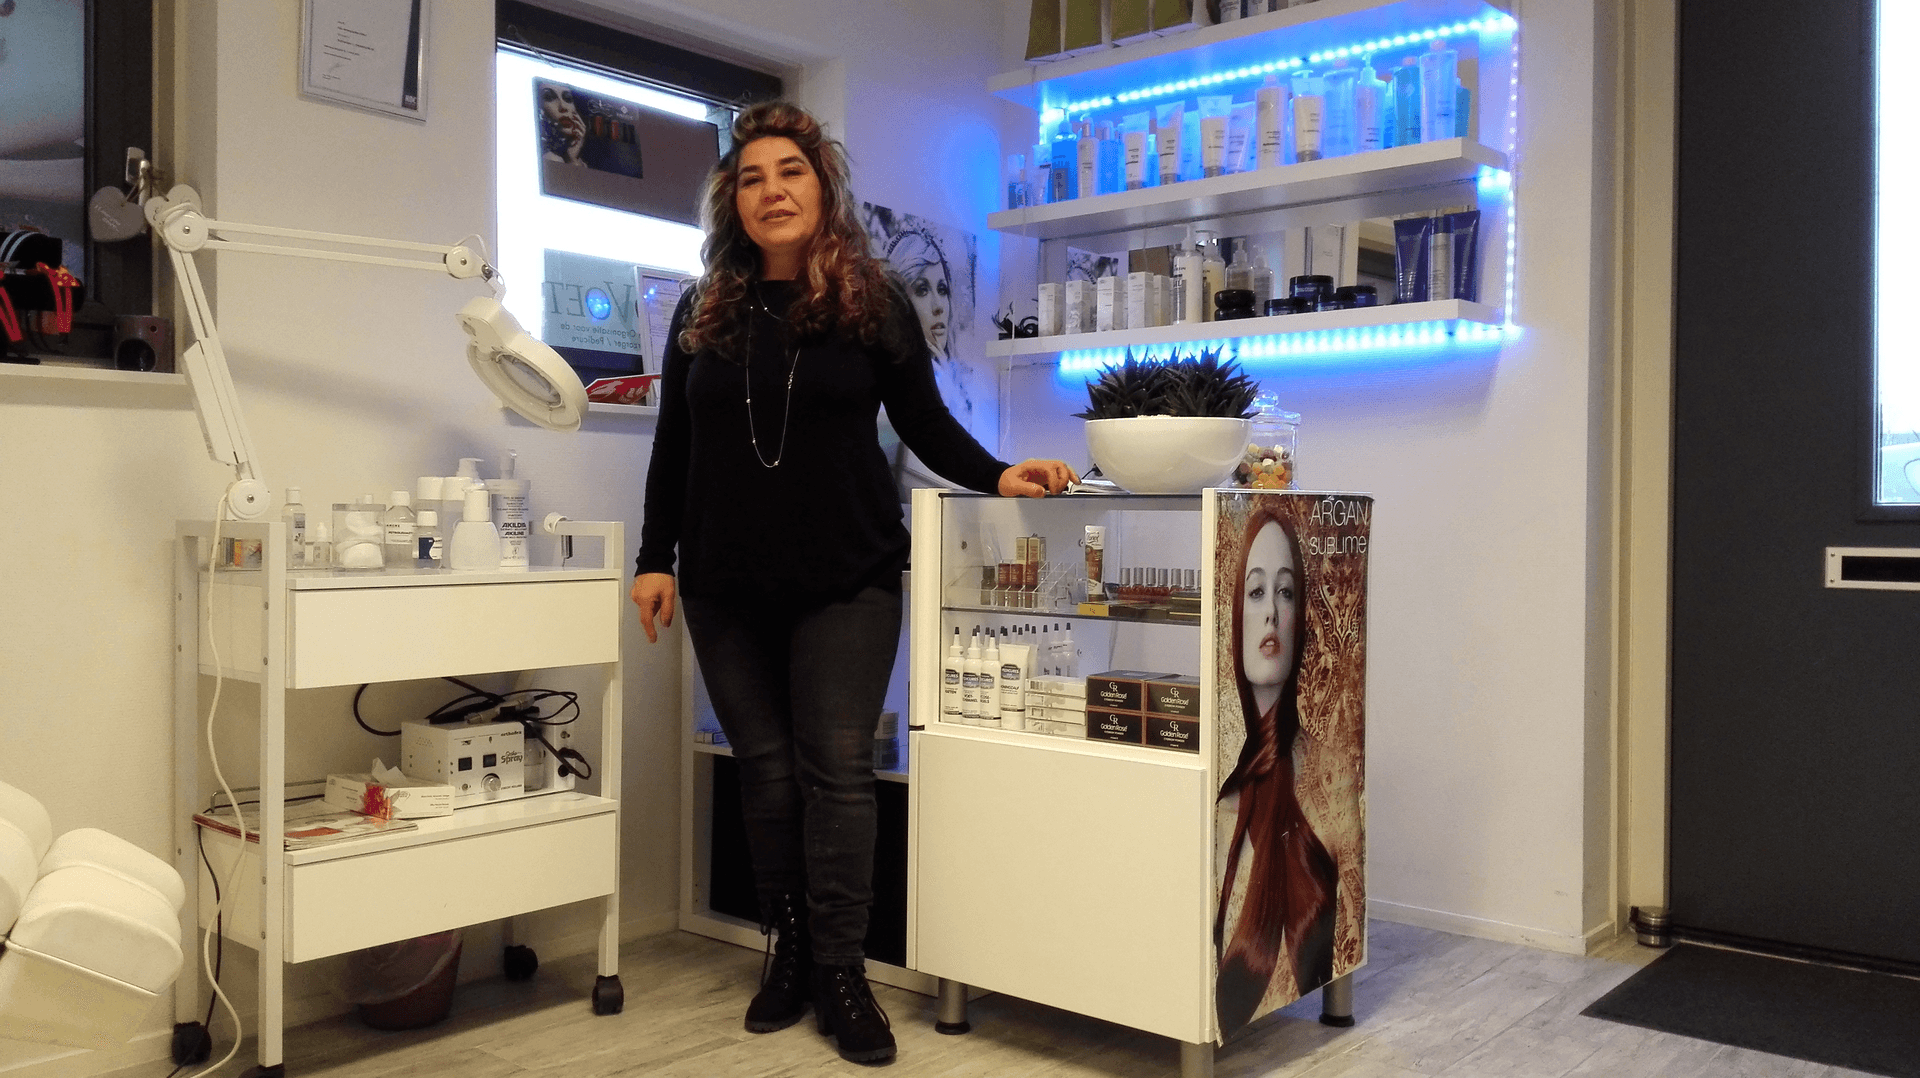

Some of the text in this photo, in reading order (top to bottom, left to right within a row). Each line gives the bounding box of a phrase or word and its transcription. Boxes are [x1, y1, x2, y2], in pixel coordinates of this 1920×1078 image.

[1309, 499, 1369, 526] ARGAN
[1100, 690, 1115, 699] Golden
[1160, 696, 1176, 704] Golden
[1100, 723, 1115, 731] Golden
[1159, 729, 1176, 738] Golden
[501, 755, 523, 765] Spray
